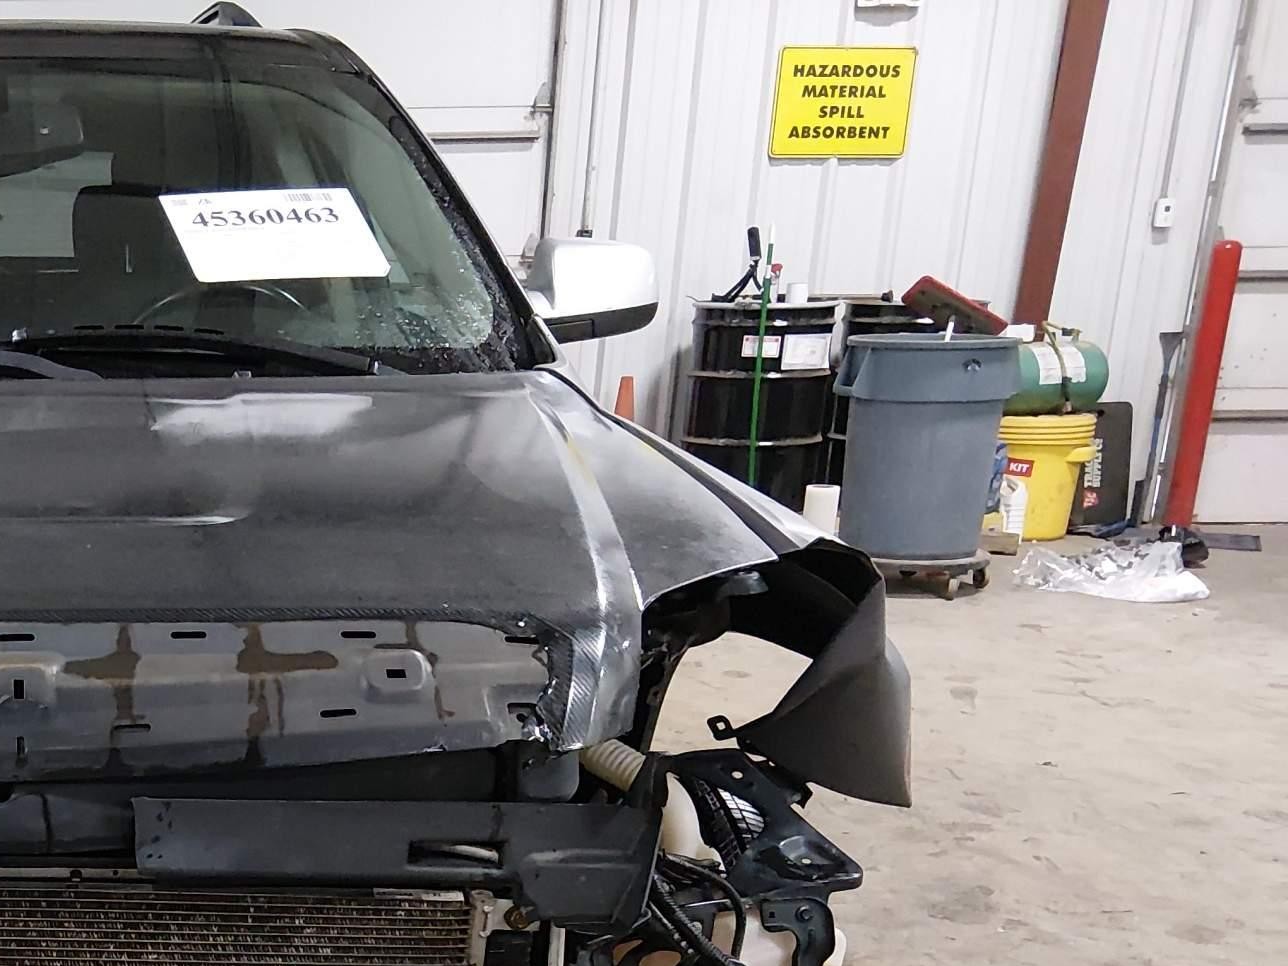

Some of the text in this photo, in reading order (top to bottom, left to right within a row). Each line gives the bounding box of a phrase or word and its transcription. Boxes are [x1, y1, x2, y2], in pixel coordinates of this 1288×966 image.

[793, 64, 901, 78] HAZARDOUS
[802, 85, 886, 98] MATERIAL
[818, 105, 865, 118] SPILL
[788, 126, 890, 139] ABSORBENT
[192, 207, 340, 227] 45360463
[1009, 462, 1030, 473] KIT
